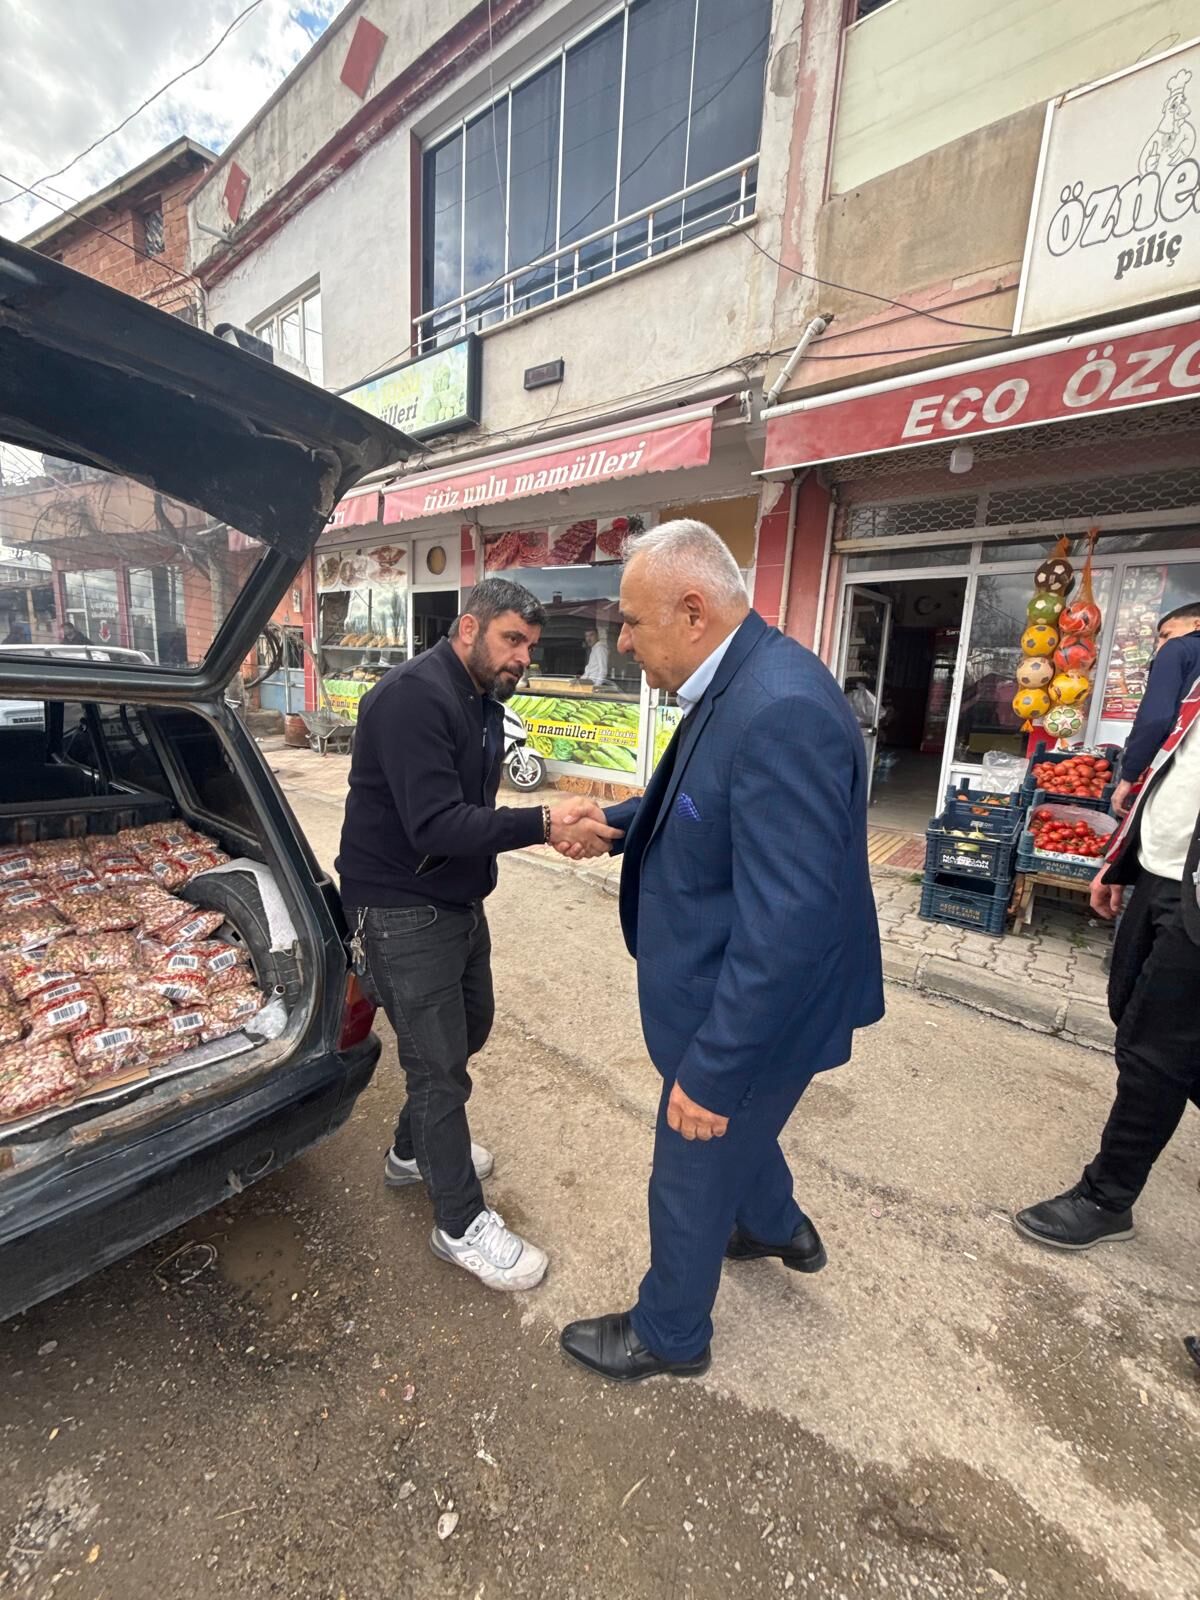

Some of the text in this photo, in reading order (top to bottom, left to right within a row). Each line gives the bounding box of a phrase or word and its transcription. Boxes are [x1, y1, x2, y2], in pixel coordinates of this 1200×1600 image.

[1047, 157, 1200, 257] özne
[1114, 231, 1182, 280] piliç
[901, 378, 1030, 439] ECO
[423, 441, 647, 512] titiz unlu mamülleri
[537, 722, 597, 740] mamülleri
